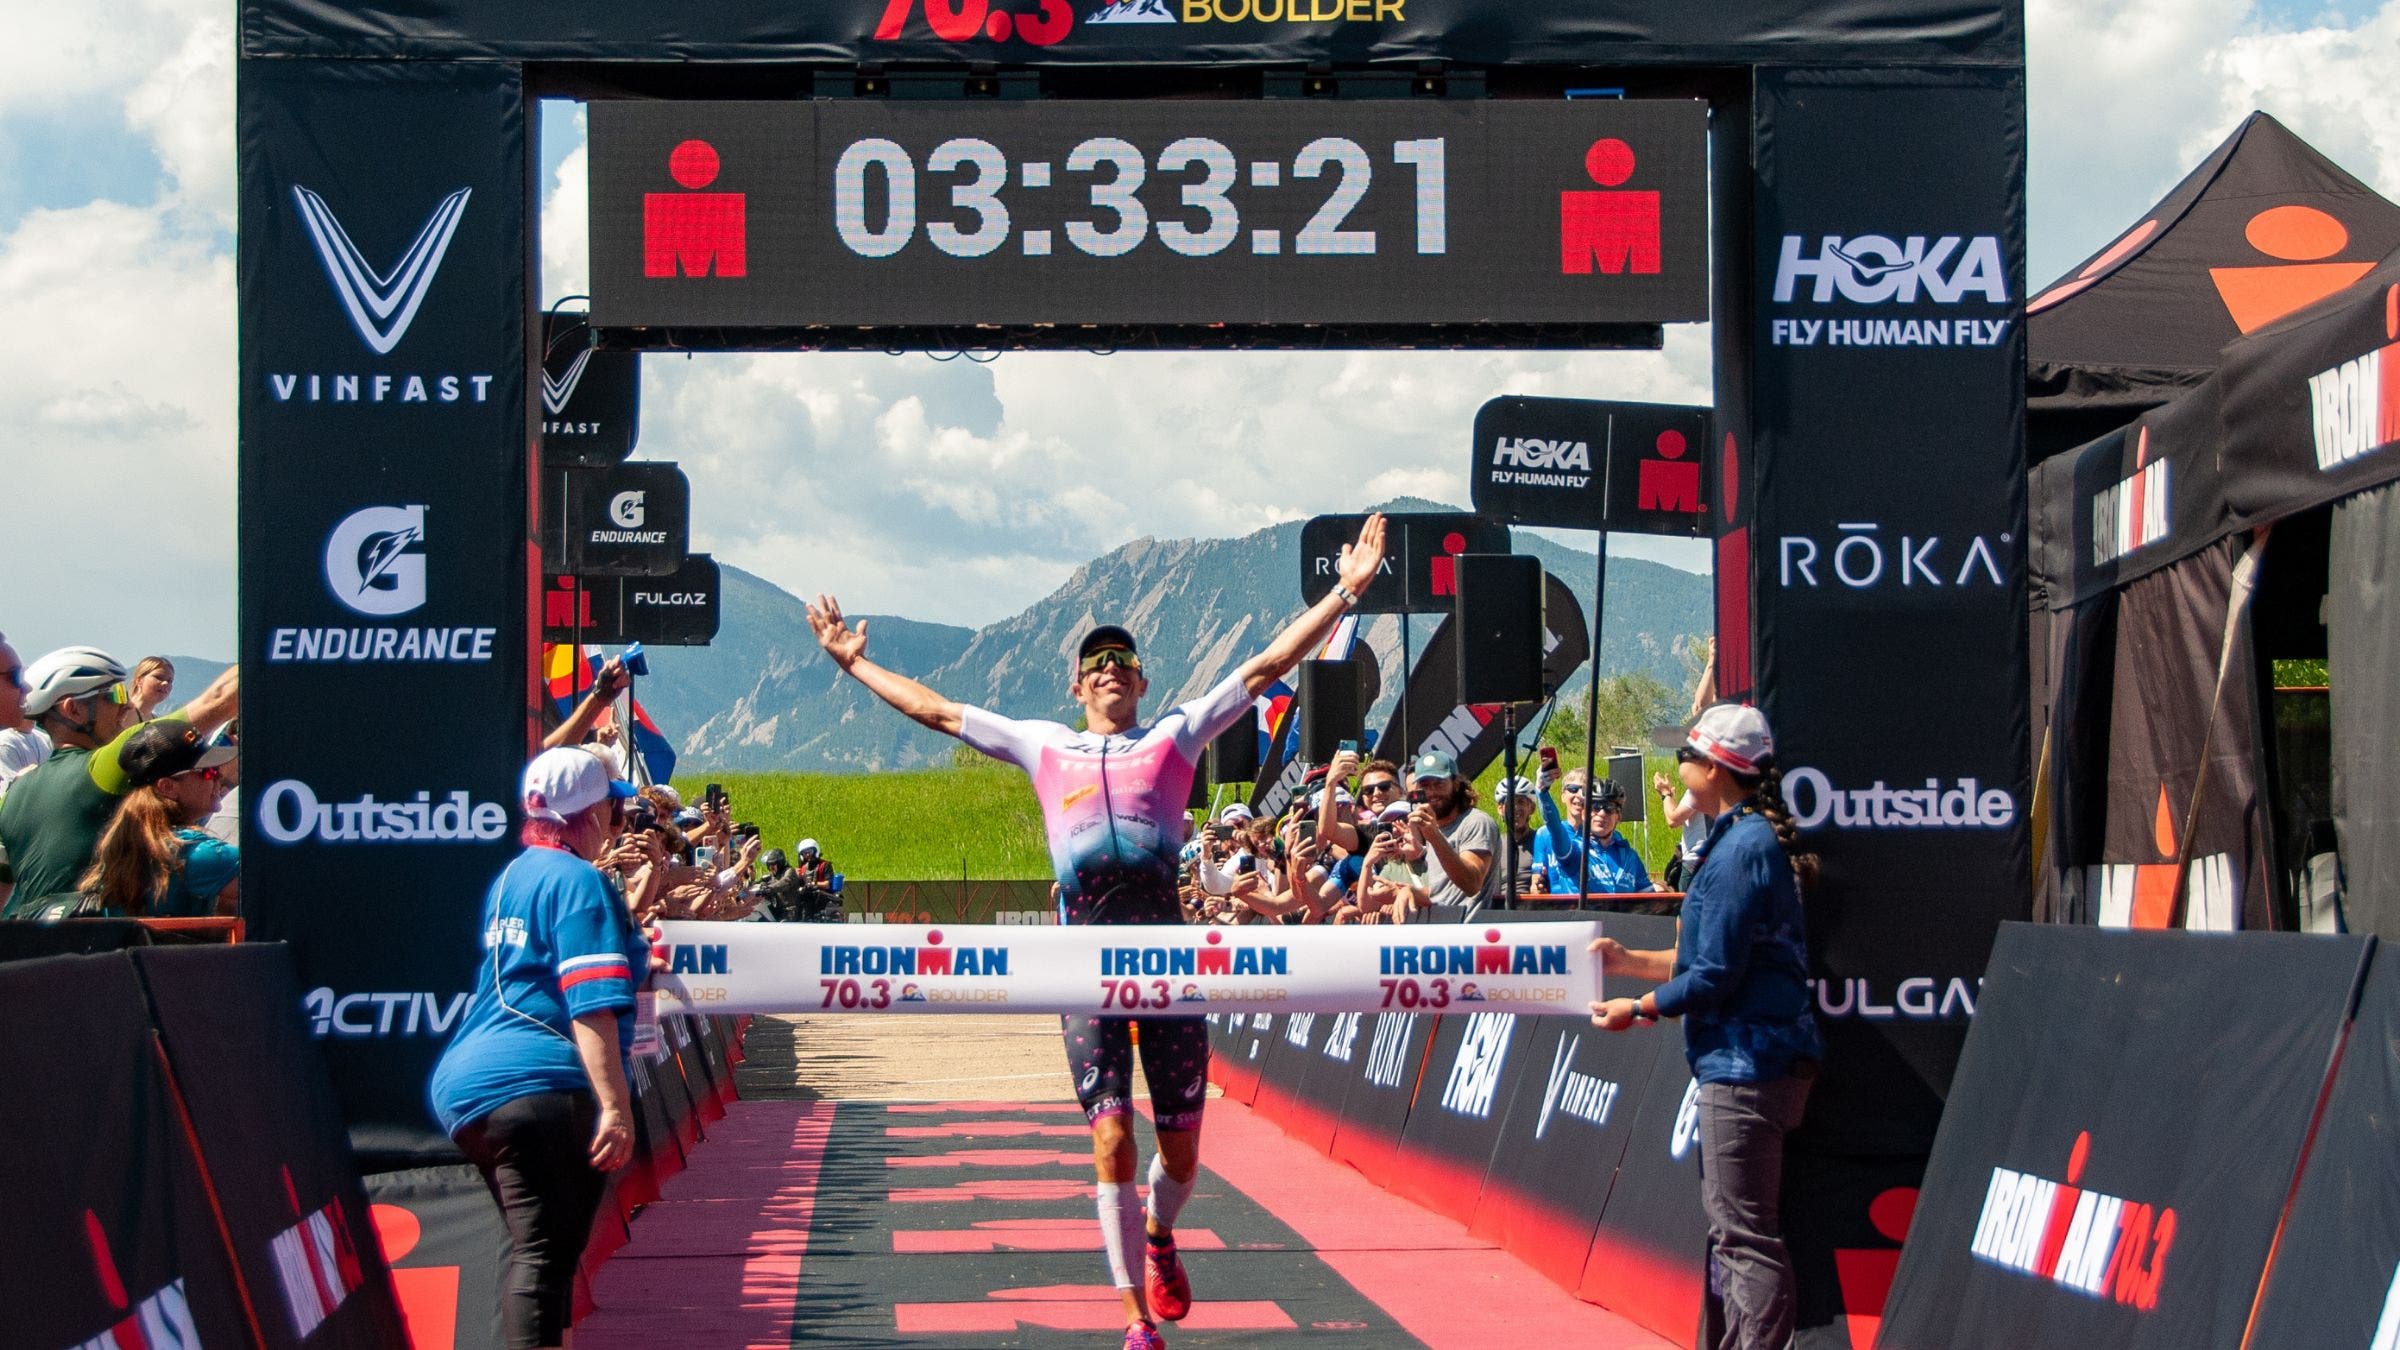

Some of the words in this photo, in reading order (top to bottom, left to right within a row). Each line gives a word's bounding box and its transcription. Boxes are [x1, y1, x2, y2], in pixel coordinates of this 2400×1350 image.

[1182, 0, 1405, 23] BOULDER
[834, 137, 1446, 257] 03:33:21
[1773, 235, 2008, 303] HOKA
[1772, 319, 1824, 346] FLY
[1829, 319, 1951, 346] HUMAN
[1955, 319, 2004, 346] FLY
[272, 374, 493, 401] VINFAST
[1493, 437, 1591, 471] HOKA
[1492, 470, 1513, 483] FLY
[1514, 472, 1565, 487] HUMAN
[1566, 476, 1590, 488] FLY
[591, 530, 667, 544] ENDURANCE
[635, 592, 707, 605] FULGAZ
[271, 627, 497, 660] ENDURANCE
[260, 779, 507, 842] Outside
[1780, 765, 2013, 829] Outside
[821, 945, 1009, 976] IRONMAN
[1101, 946, 1288, 976] IRONMAN
[1379, 945, 1567, 976] IRONMAN
[820, 978, 891, 1010] 70.3
[928, 987, 1009, 1003] BOULDER
[1100, 979, 1171, 1010] 70.3
[1208, 987, 1288, 1002] BOULDER
[1379, 978, 1450, 1009] 70.3
[1487, 987, 1568, 1002] BOULDER
[1806, 976, 1985, 1015] ULGA
[305, 986, 478, 1034] ACTIV
